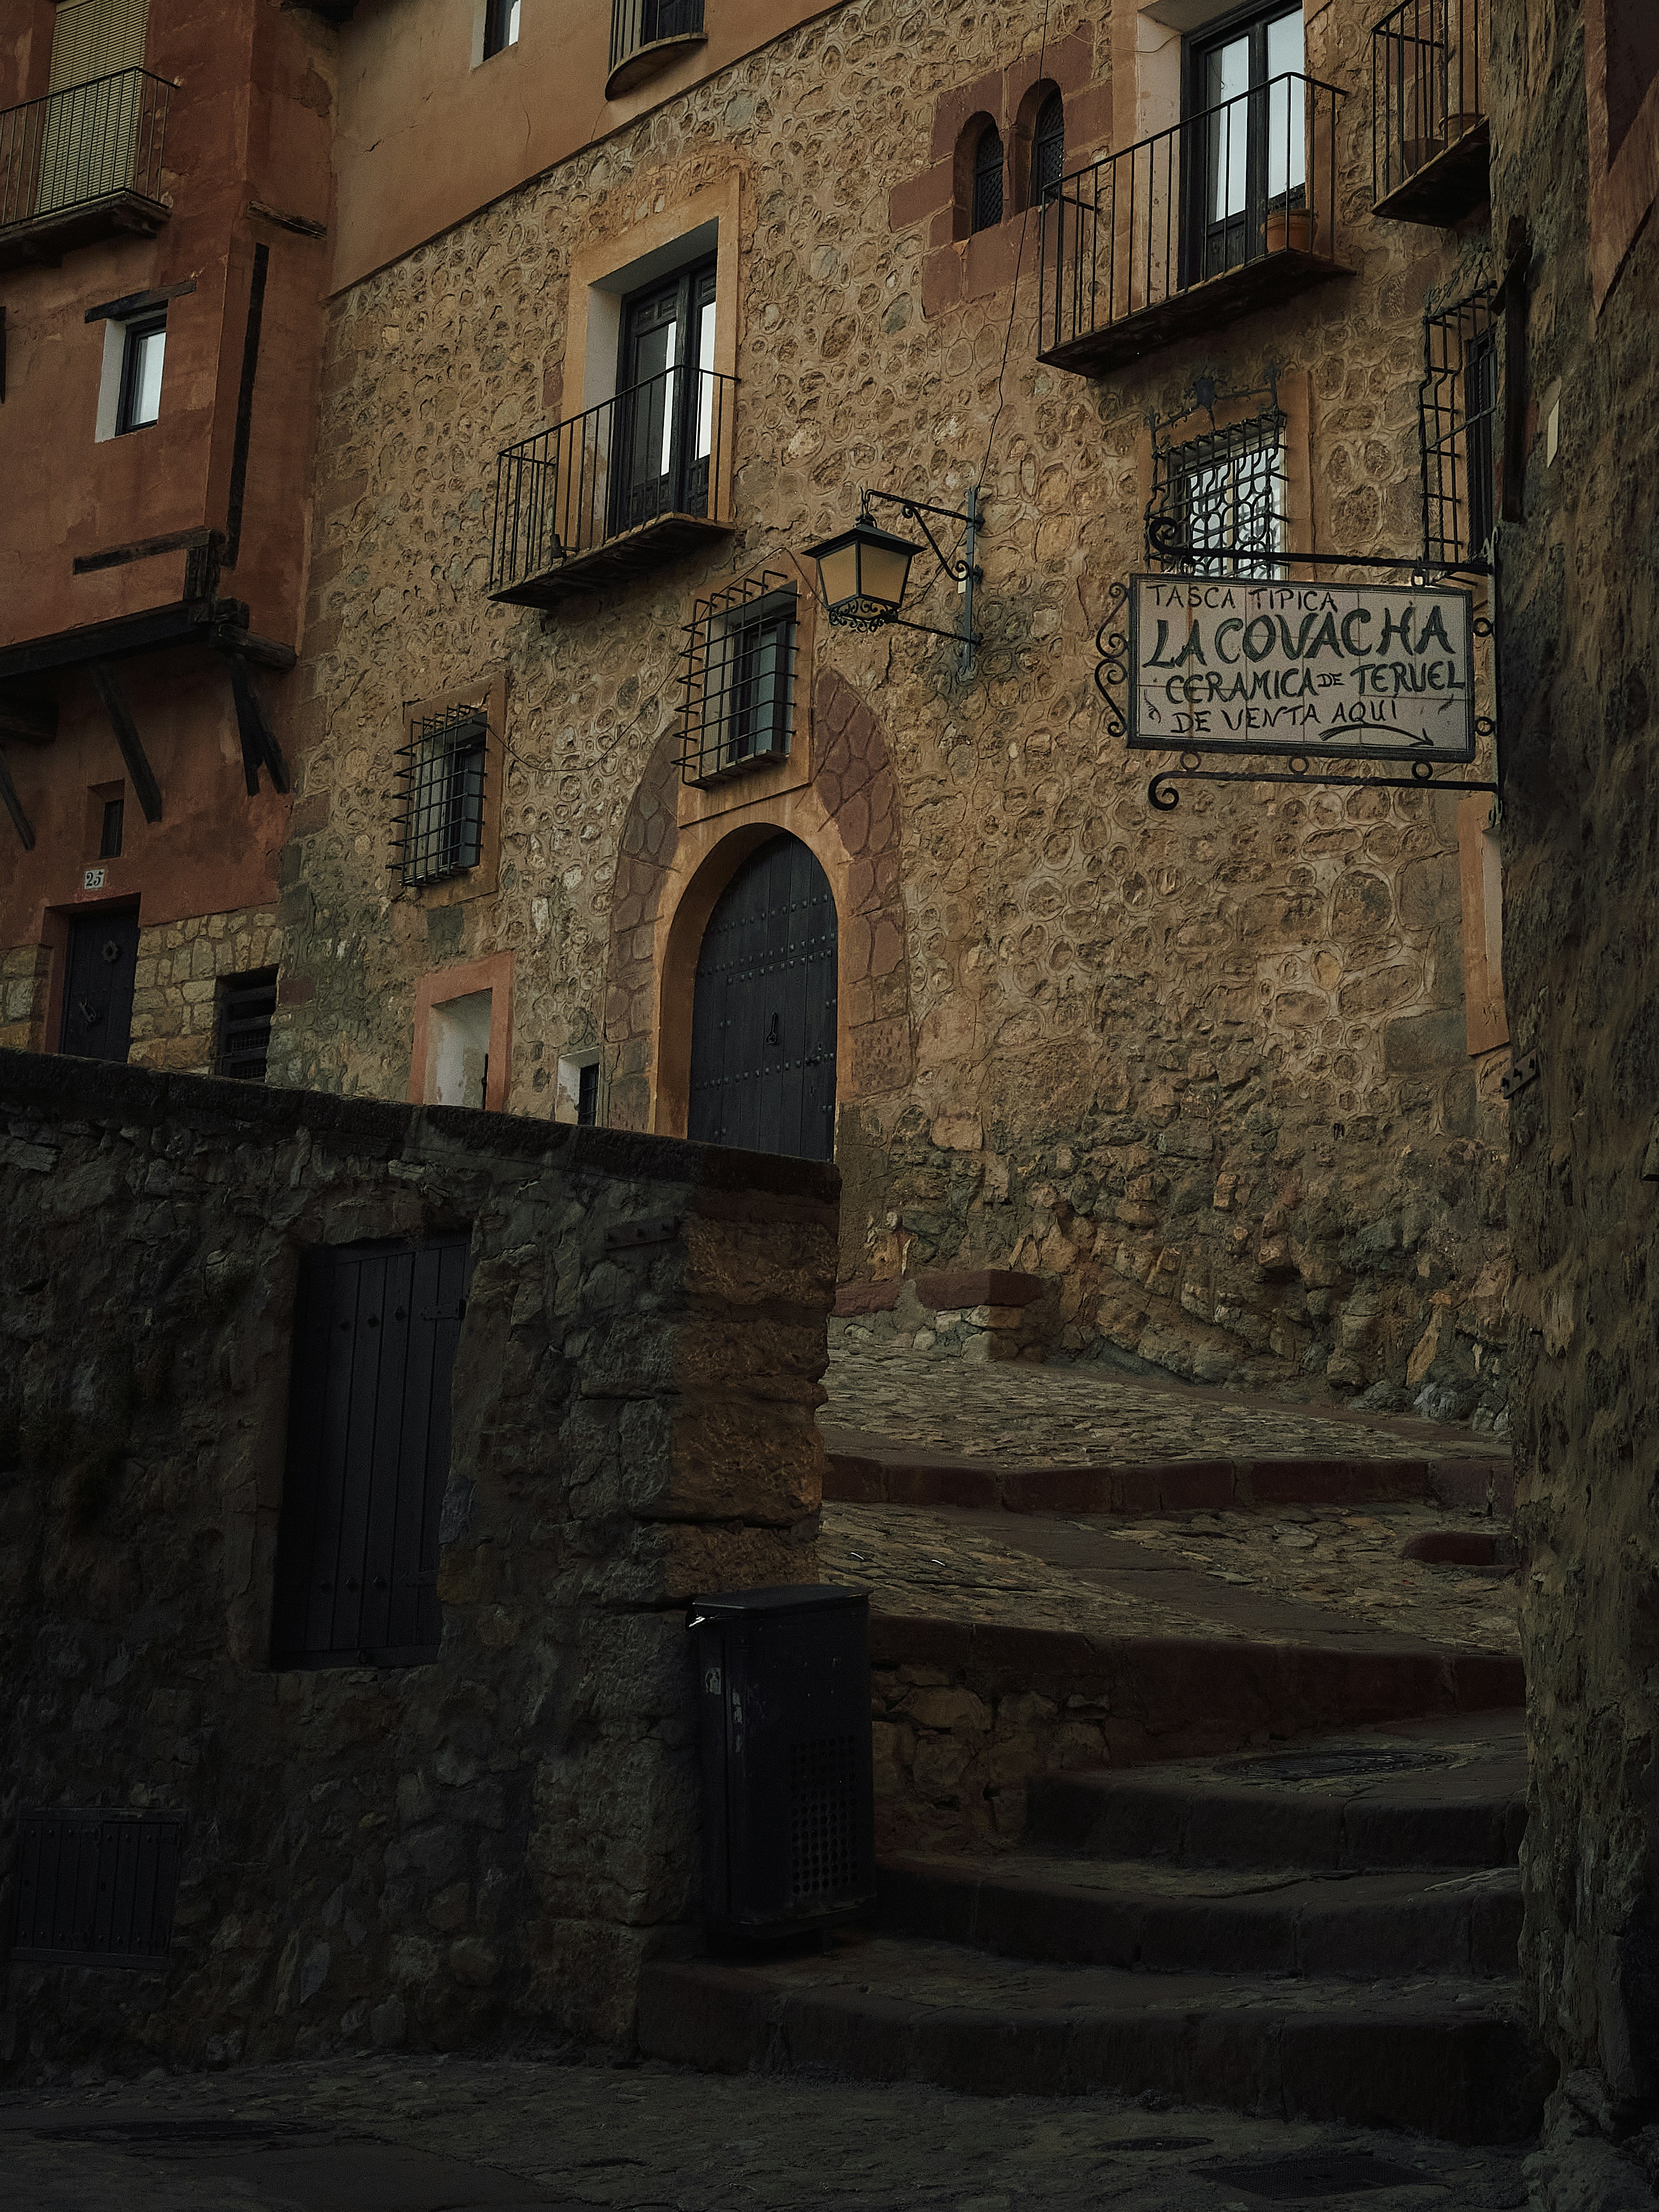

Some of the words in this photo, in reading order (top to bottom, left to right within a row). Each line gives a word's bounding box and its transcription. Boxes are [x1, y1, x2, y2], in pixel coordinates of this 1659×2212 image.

[1146, 584, 1235, 609] TASCA
[1249, 588, 1338, 613] TIPICA
[1143, 619, 1207, 668] LA
[1214, 605, 1456, 664] COVACHA
[1165, 667, 1319, 703] CERAMICA
[1317, 673, 1344, 687] DE
[1350, 660, 1465, 694] TERUEL
[1171, 710, 1211, 733] DE
[1221, 703, 1321, 730] VENTA
[86, 871, 104, 887] 25
